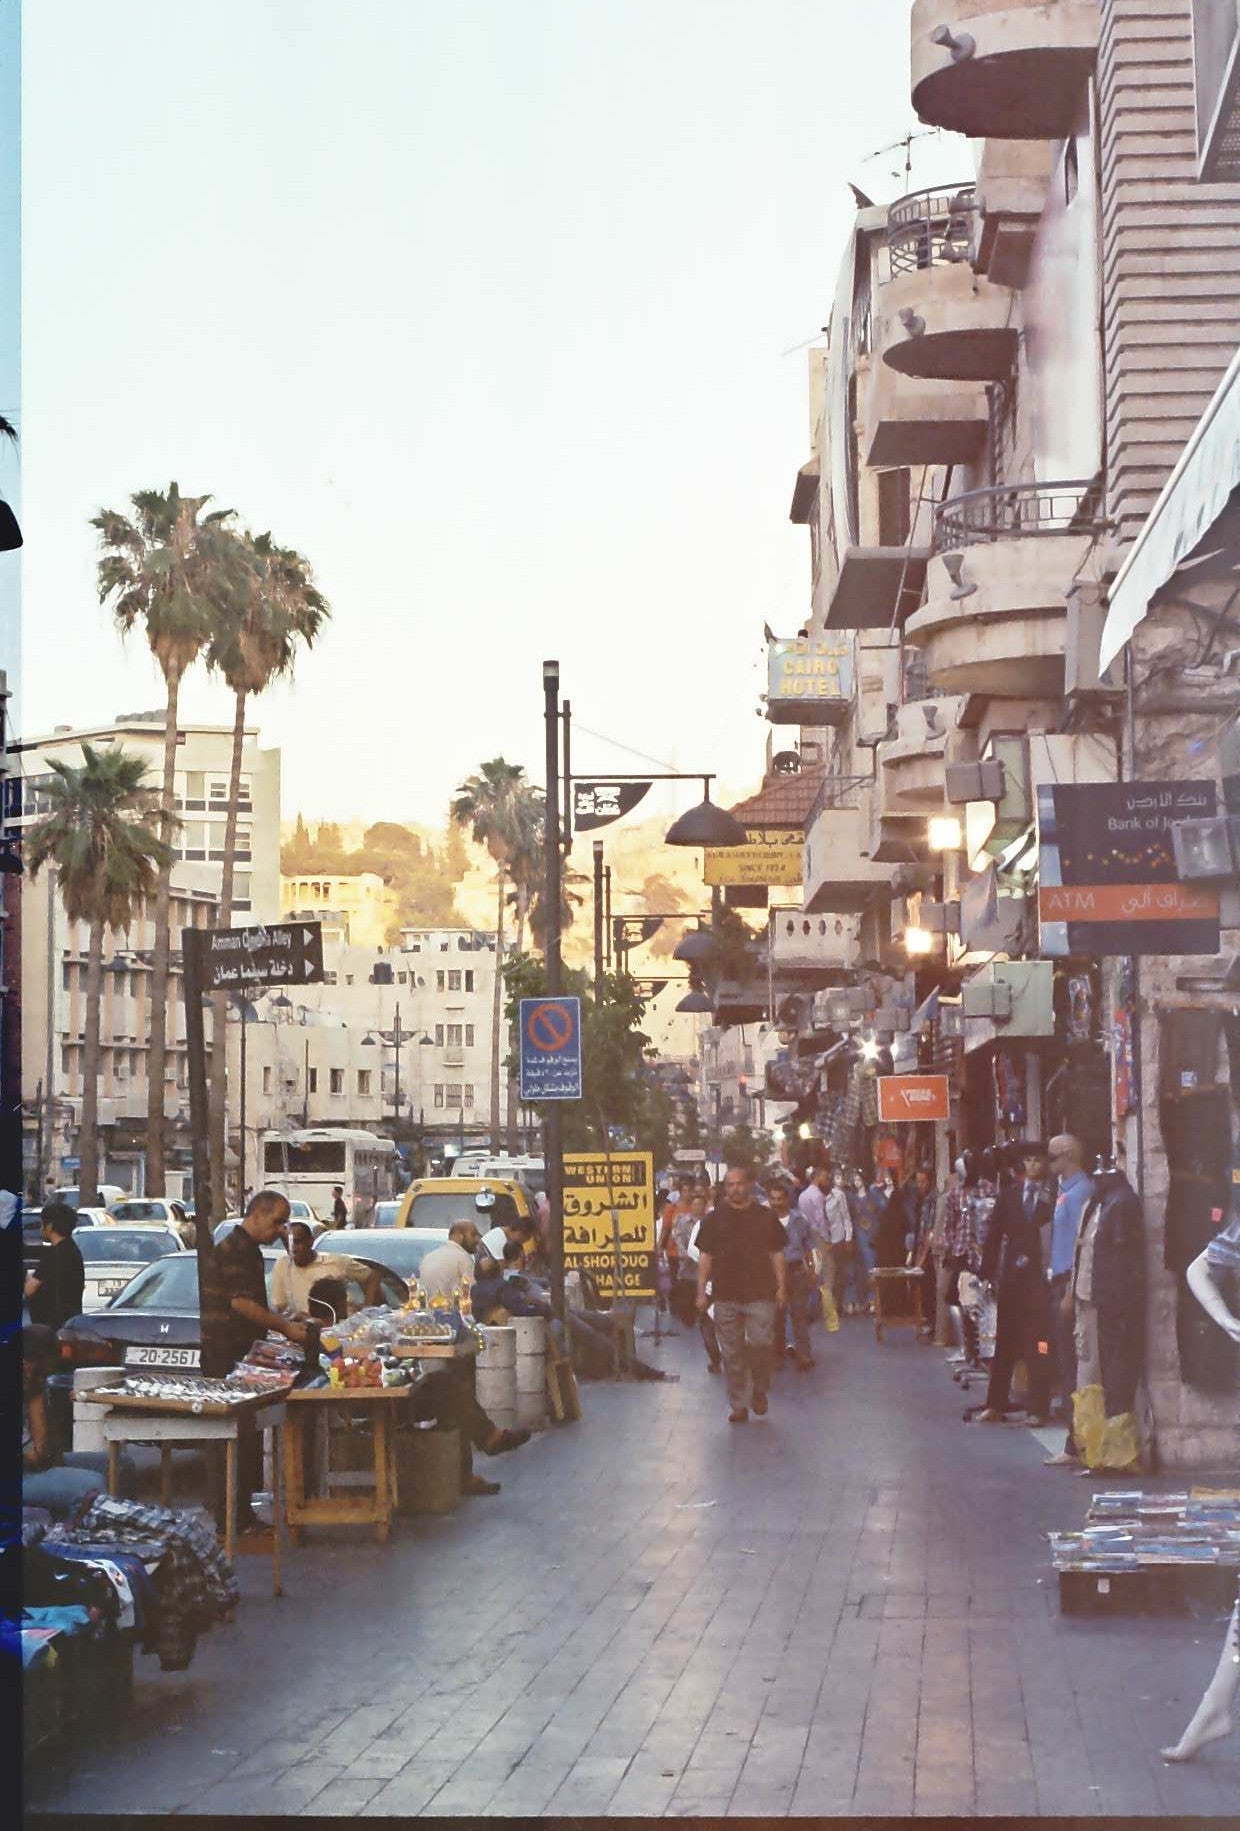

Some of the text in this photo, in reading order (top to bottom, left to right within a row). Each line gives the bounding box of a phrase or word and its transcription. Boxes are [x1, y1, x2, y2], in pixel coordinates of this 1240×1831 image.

[783, 658, 838, 675] CAIRO
[780, 678, 841, 696] HOTEL
[1175, 792, 1208, 807] بنك
[1107, 816, 1142, 831] Bank
[1145, 816, 1159, 829] of
[1048, 891, 1097, 911] ATM
[211, 934, 241, 951] Amman
[272, 930, 292, 949] Alley
[213, 964, 238, 985] عمان
[586, 1174, 632, 1184] UNON
[563, 1191, 647, 1216] الشروق
[564, 1225, 647, 1249] للصرافة
